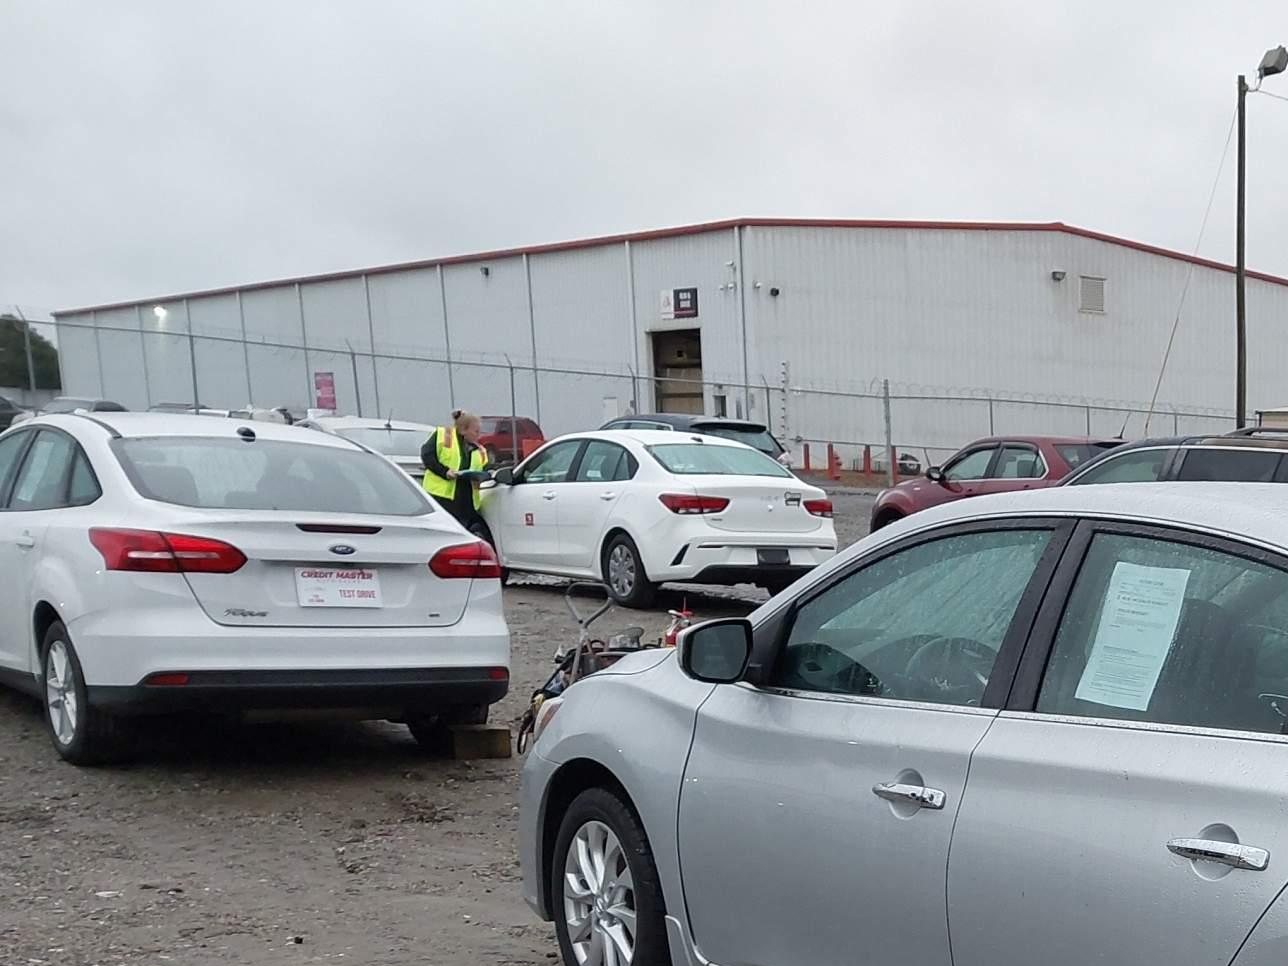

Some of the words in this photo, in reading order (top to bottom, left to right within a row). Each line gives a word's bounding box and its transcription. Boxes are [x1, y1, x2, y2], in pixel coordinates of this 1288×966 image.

[300, 571, 334, 579] CREDIT
[335, 571, 374, 580] MASTER
[339, 589, 356, 598] TEST
[356, 590, 377, 599] DRIVE
